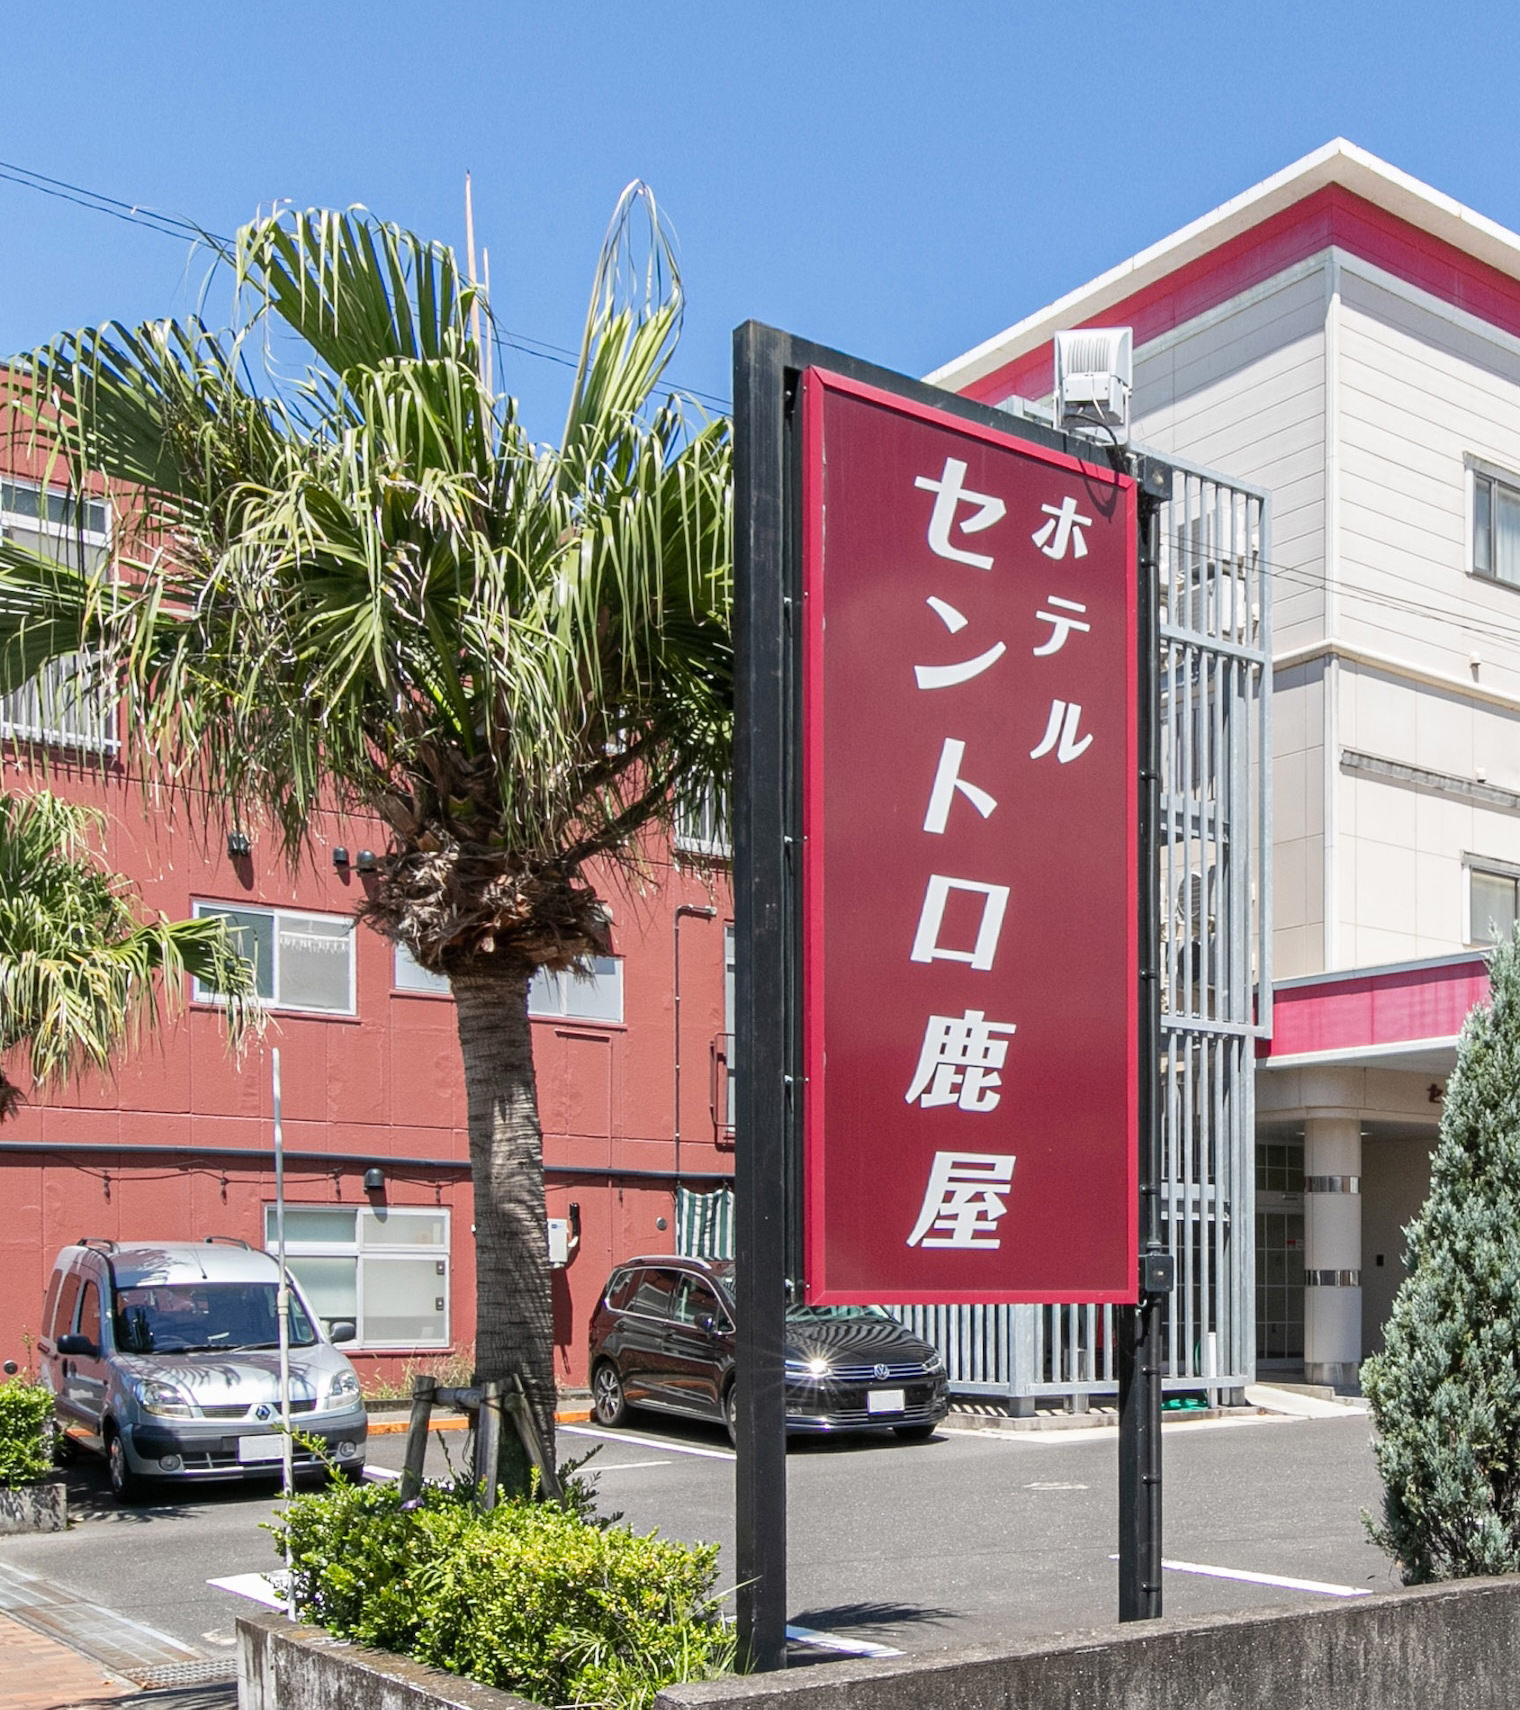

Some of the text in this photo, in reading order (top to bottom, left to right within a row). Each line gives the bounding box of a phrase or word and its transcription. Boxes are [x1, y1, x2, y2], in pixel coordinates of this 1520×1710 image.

[904, 457, 1016, 1250] セントロ鹿屋
[1030, 496, 1094, 764] ホテル
